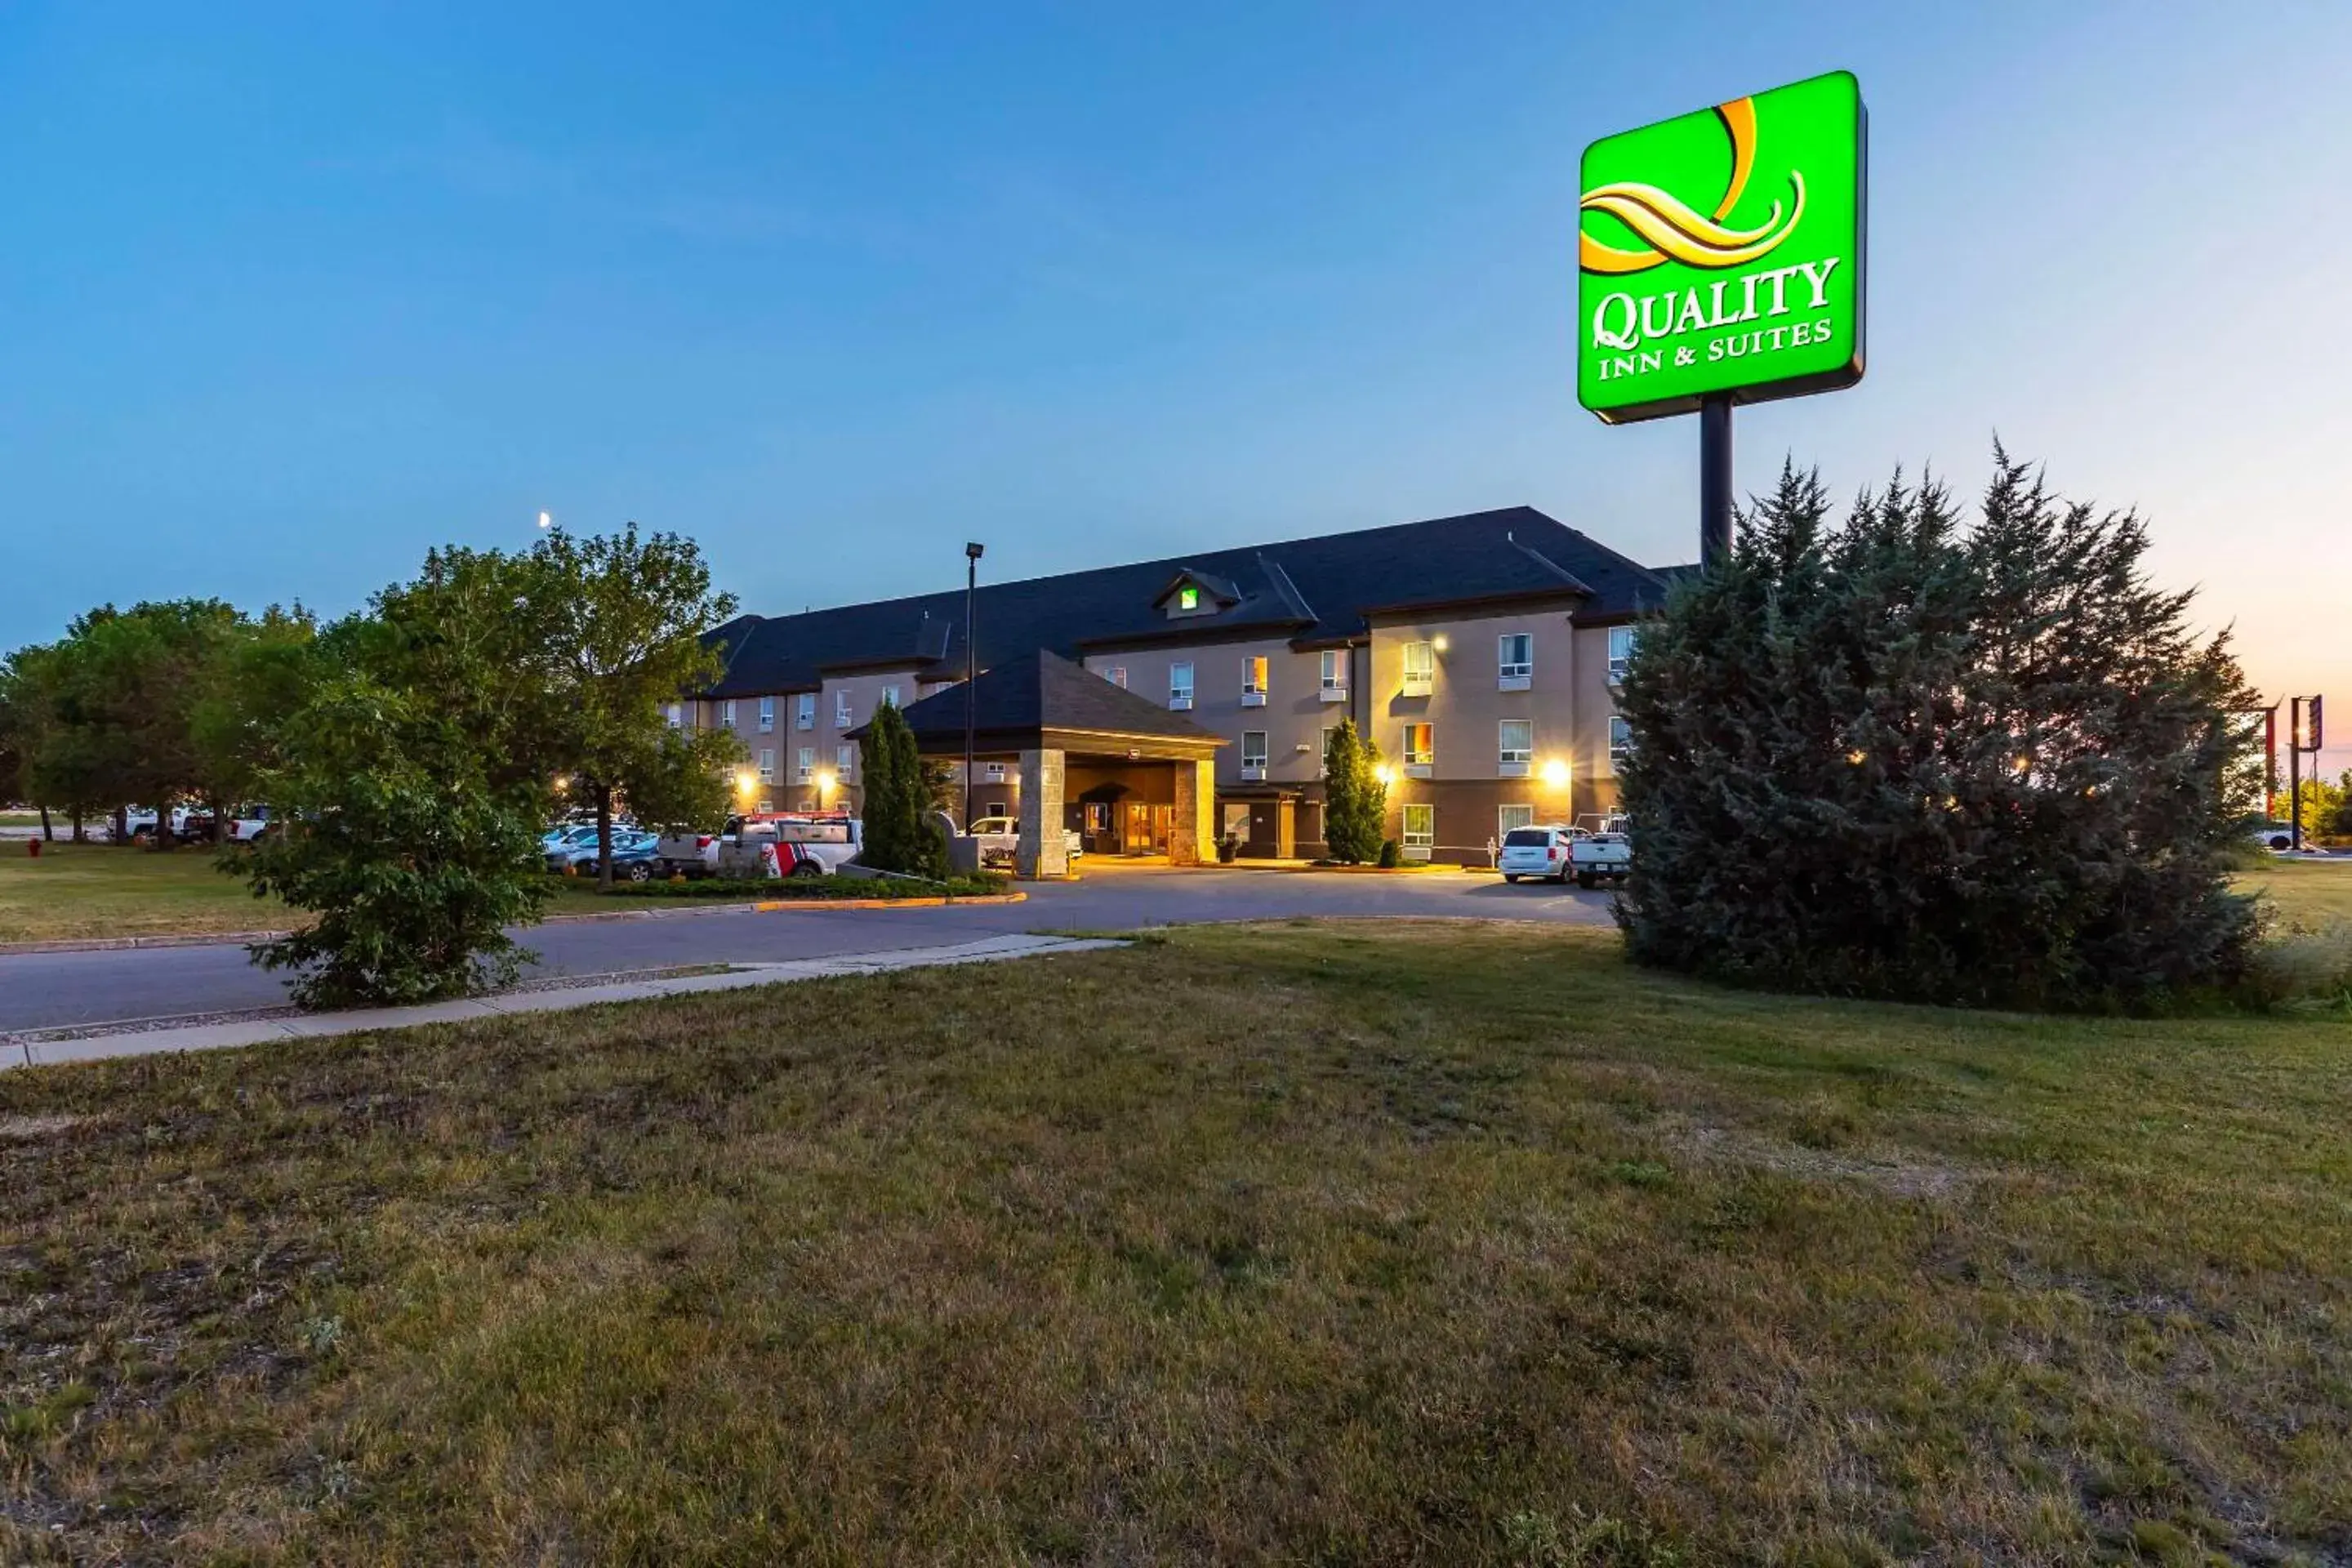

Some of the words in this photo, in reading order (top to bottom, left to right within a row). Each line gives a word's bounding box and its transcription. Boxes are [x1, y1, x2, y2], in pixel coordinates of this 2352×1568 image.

[1593, 257, 1840, 350] QUALITY
[1598, 350, 1663, 381] INN
[1674, 346, 1696, 366] &
[1708, 318, 1832, 361] SUITES
